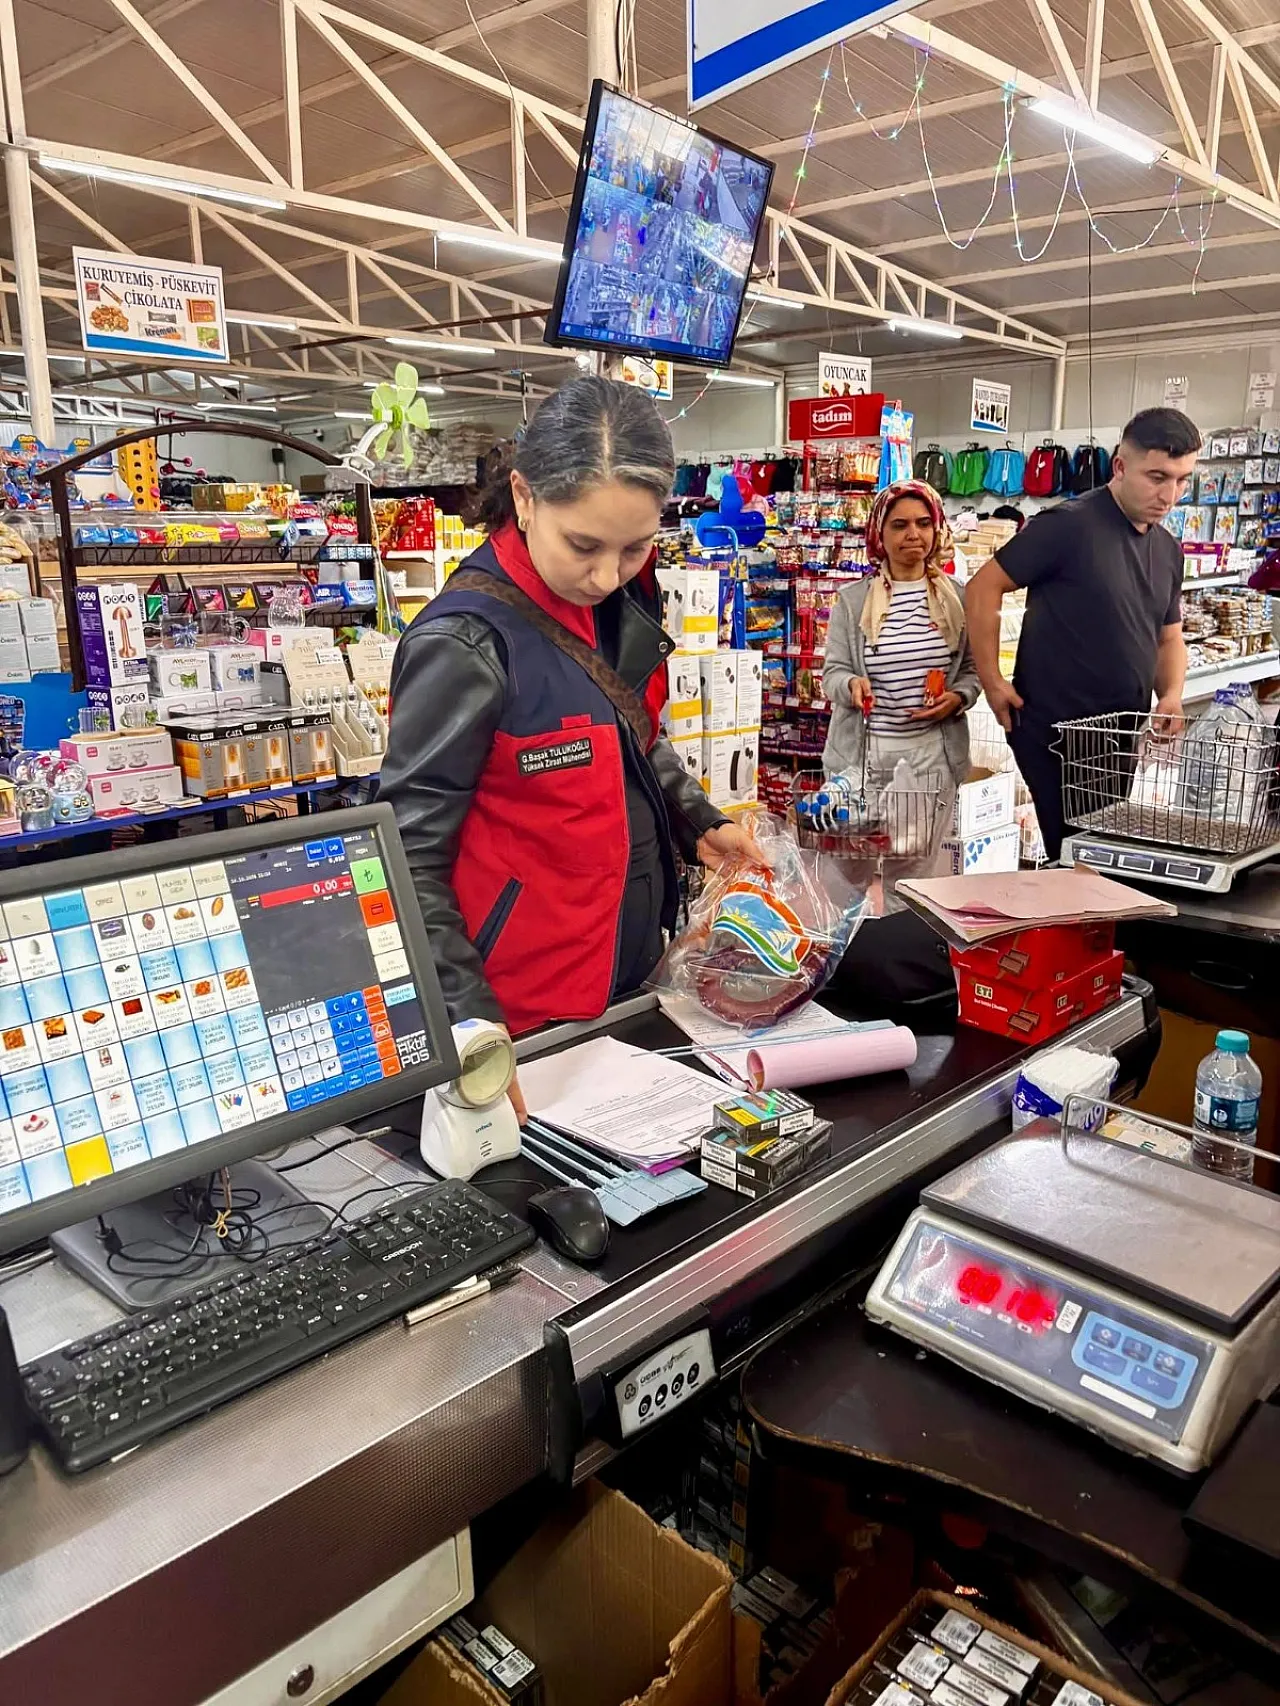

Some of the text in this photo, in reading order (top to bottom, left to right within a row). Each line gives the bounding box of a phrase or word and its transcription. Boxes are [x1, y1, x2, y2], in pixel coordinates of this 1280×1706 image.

[83, 266, 154, 290] KURUYEMİŞ
[162, 275, 216, 296] PÜSKEVİT
[124, 290, 184, 310] ÇİKOLATA
[824, 365, 867, 382] OYUNCAK
[812, 409, 852, 424] tadım
[550, 740, 590, 758] TULUKOĞLU
[312, 880, 338, 894] 0,00
[334, 1003, 339, 1012] C
[315, 1009, 320, 1017] 9
[296, 1015, 301, 1023] 8
[276, 1020, 281, 1028] 7
[337, 1021, 344, 1030] X
[320, 1027, 325, 1035] 6
[301, 1033, 306, 1042] 5
[281, 1039, 286, 1048] 4
[398, 1036, 427, 1054] Aktif
[324, 1046, 330, 1054] 3
[306, 1052, 311, 1060] 2
[401, 1049, 429, 1068] POS
[286, 1058, 291, 1066] 1
[290, 1077, 296, 1085] 0
